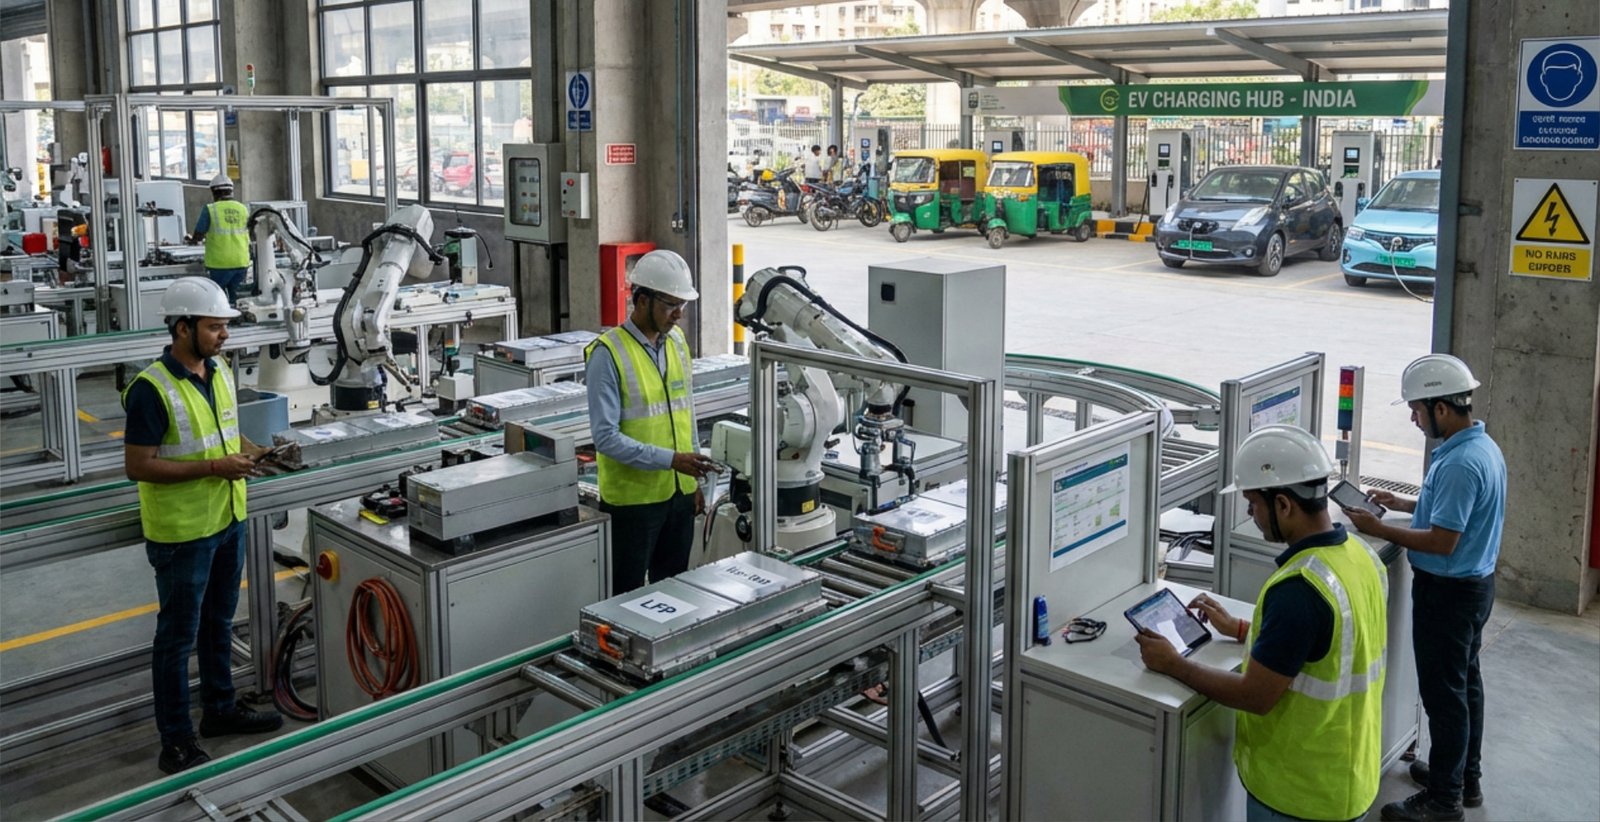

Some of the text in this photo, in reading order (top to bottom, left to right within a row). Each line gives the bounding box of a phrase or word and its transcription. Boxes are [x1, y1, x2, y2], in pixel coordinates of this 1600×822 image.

[1128, 91, 1149, 108] EV
[1153, 91, 1240, 108] CHARGING
[1246, 90, 1284, 108] HUB
[1303, 88, 1357, 108] INDIA
[640, 599, 677, 613] LFP
